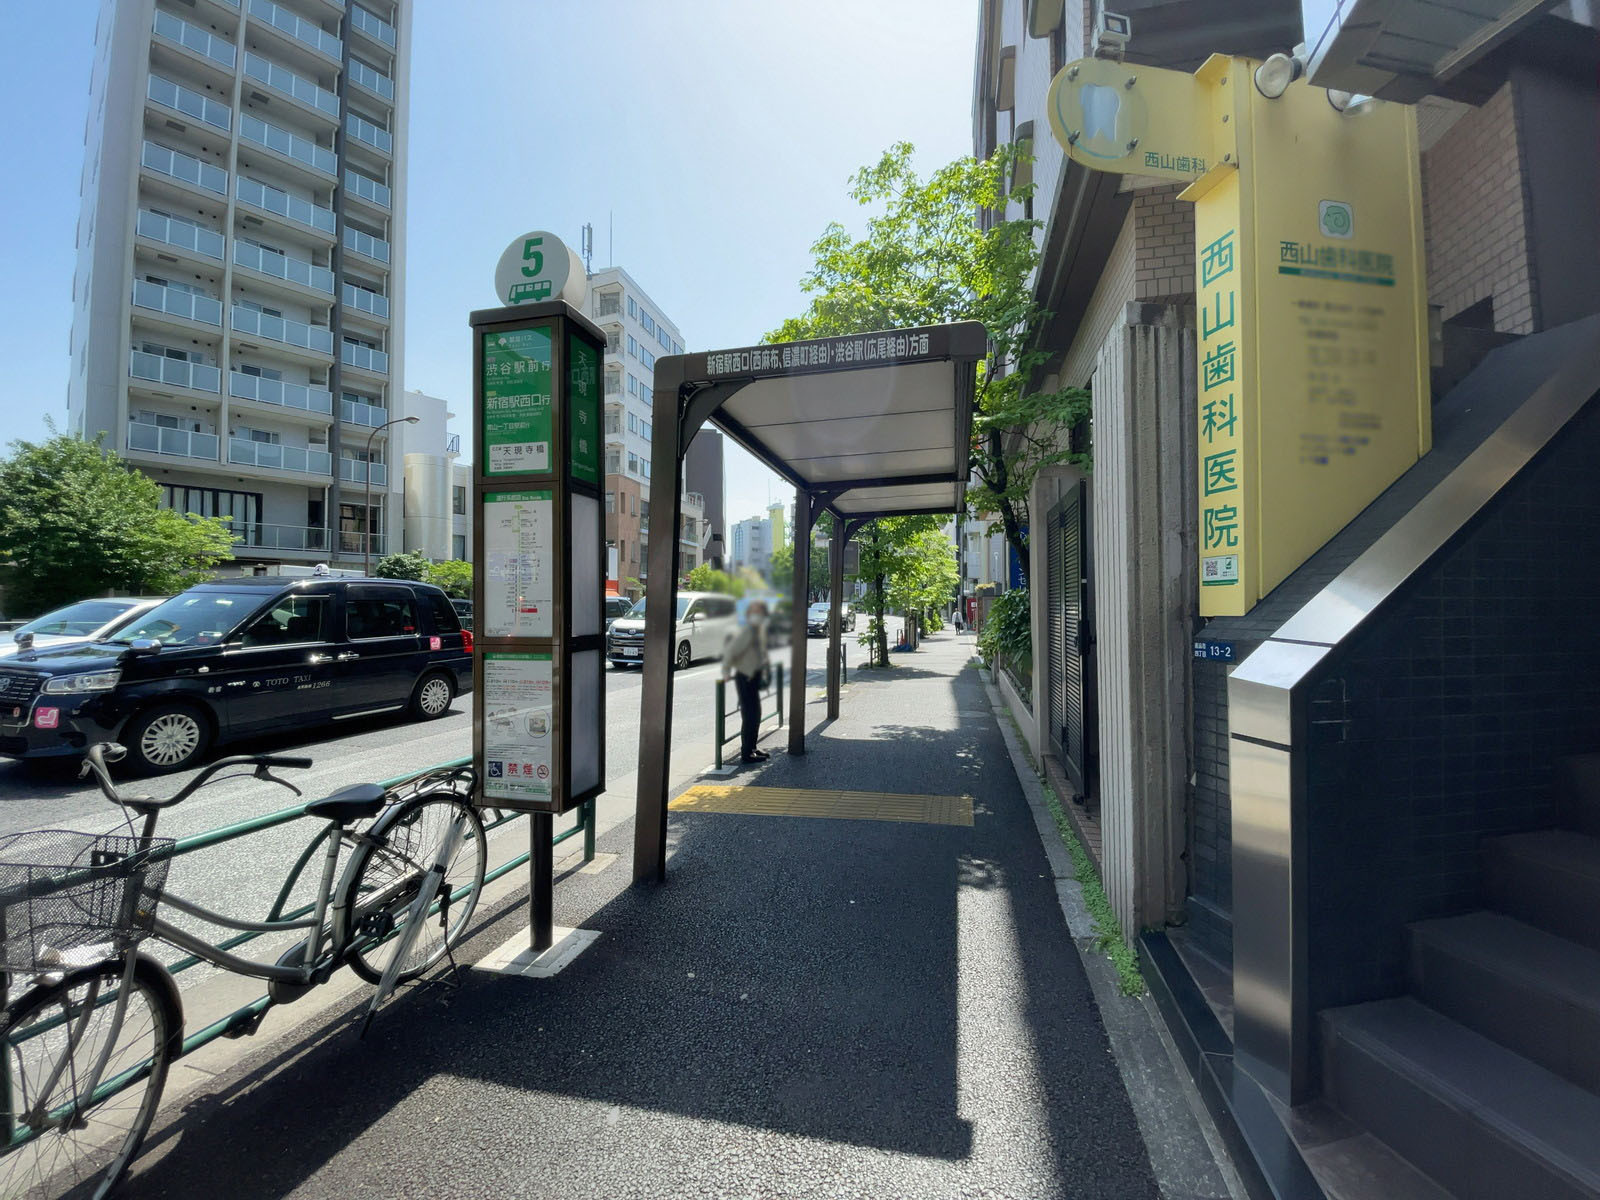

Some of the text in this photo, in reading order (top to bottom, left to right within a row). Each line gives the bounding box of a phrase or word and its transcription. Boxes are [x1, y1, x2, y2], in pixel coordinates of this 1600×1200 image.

[1144, 151, 1206, 174] 西山歯科
[520, 237, 544, 278] 5
[486, 360, 551, 376] 渋谷駅前行
[1201, 229, 1238, 551] 西山歯科医院
[486, 394, 551, 410] 新宿駅西口行
[503, 444, 545, 455] 天現寺橋
[1210, 645, 1231, 657] 13-2
[265, 674, 312, 687] TOTO TAXI
[507, 763, 534, 775] 禁煙
